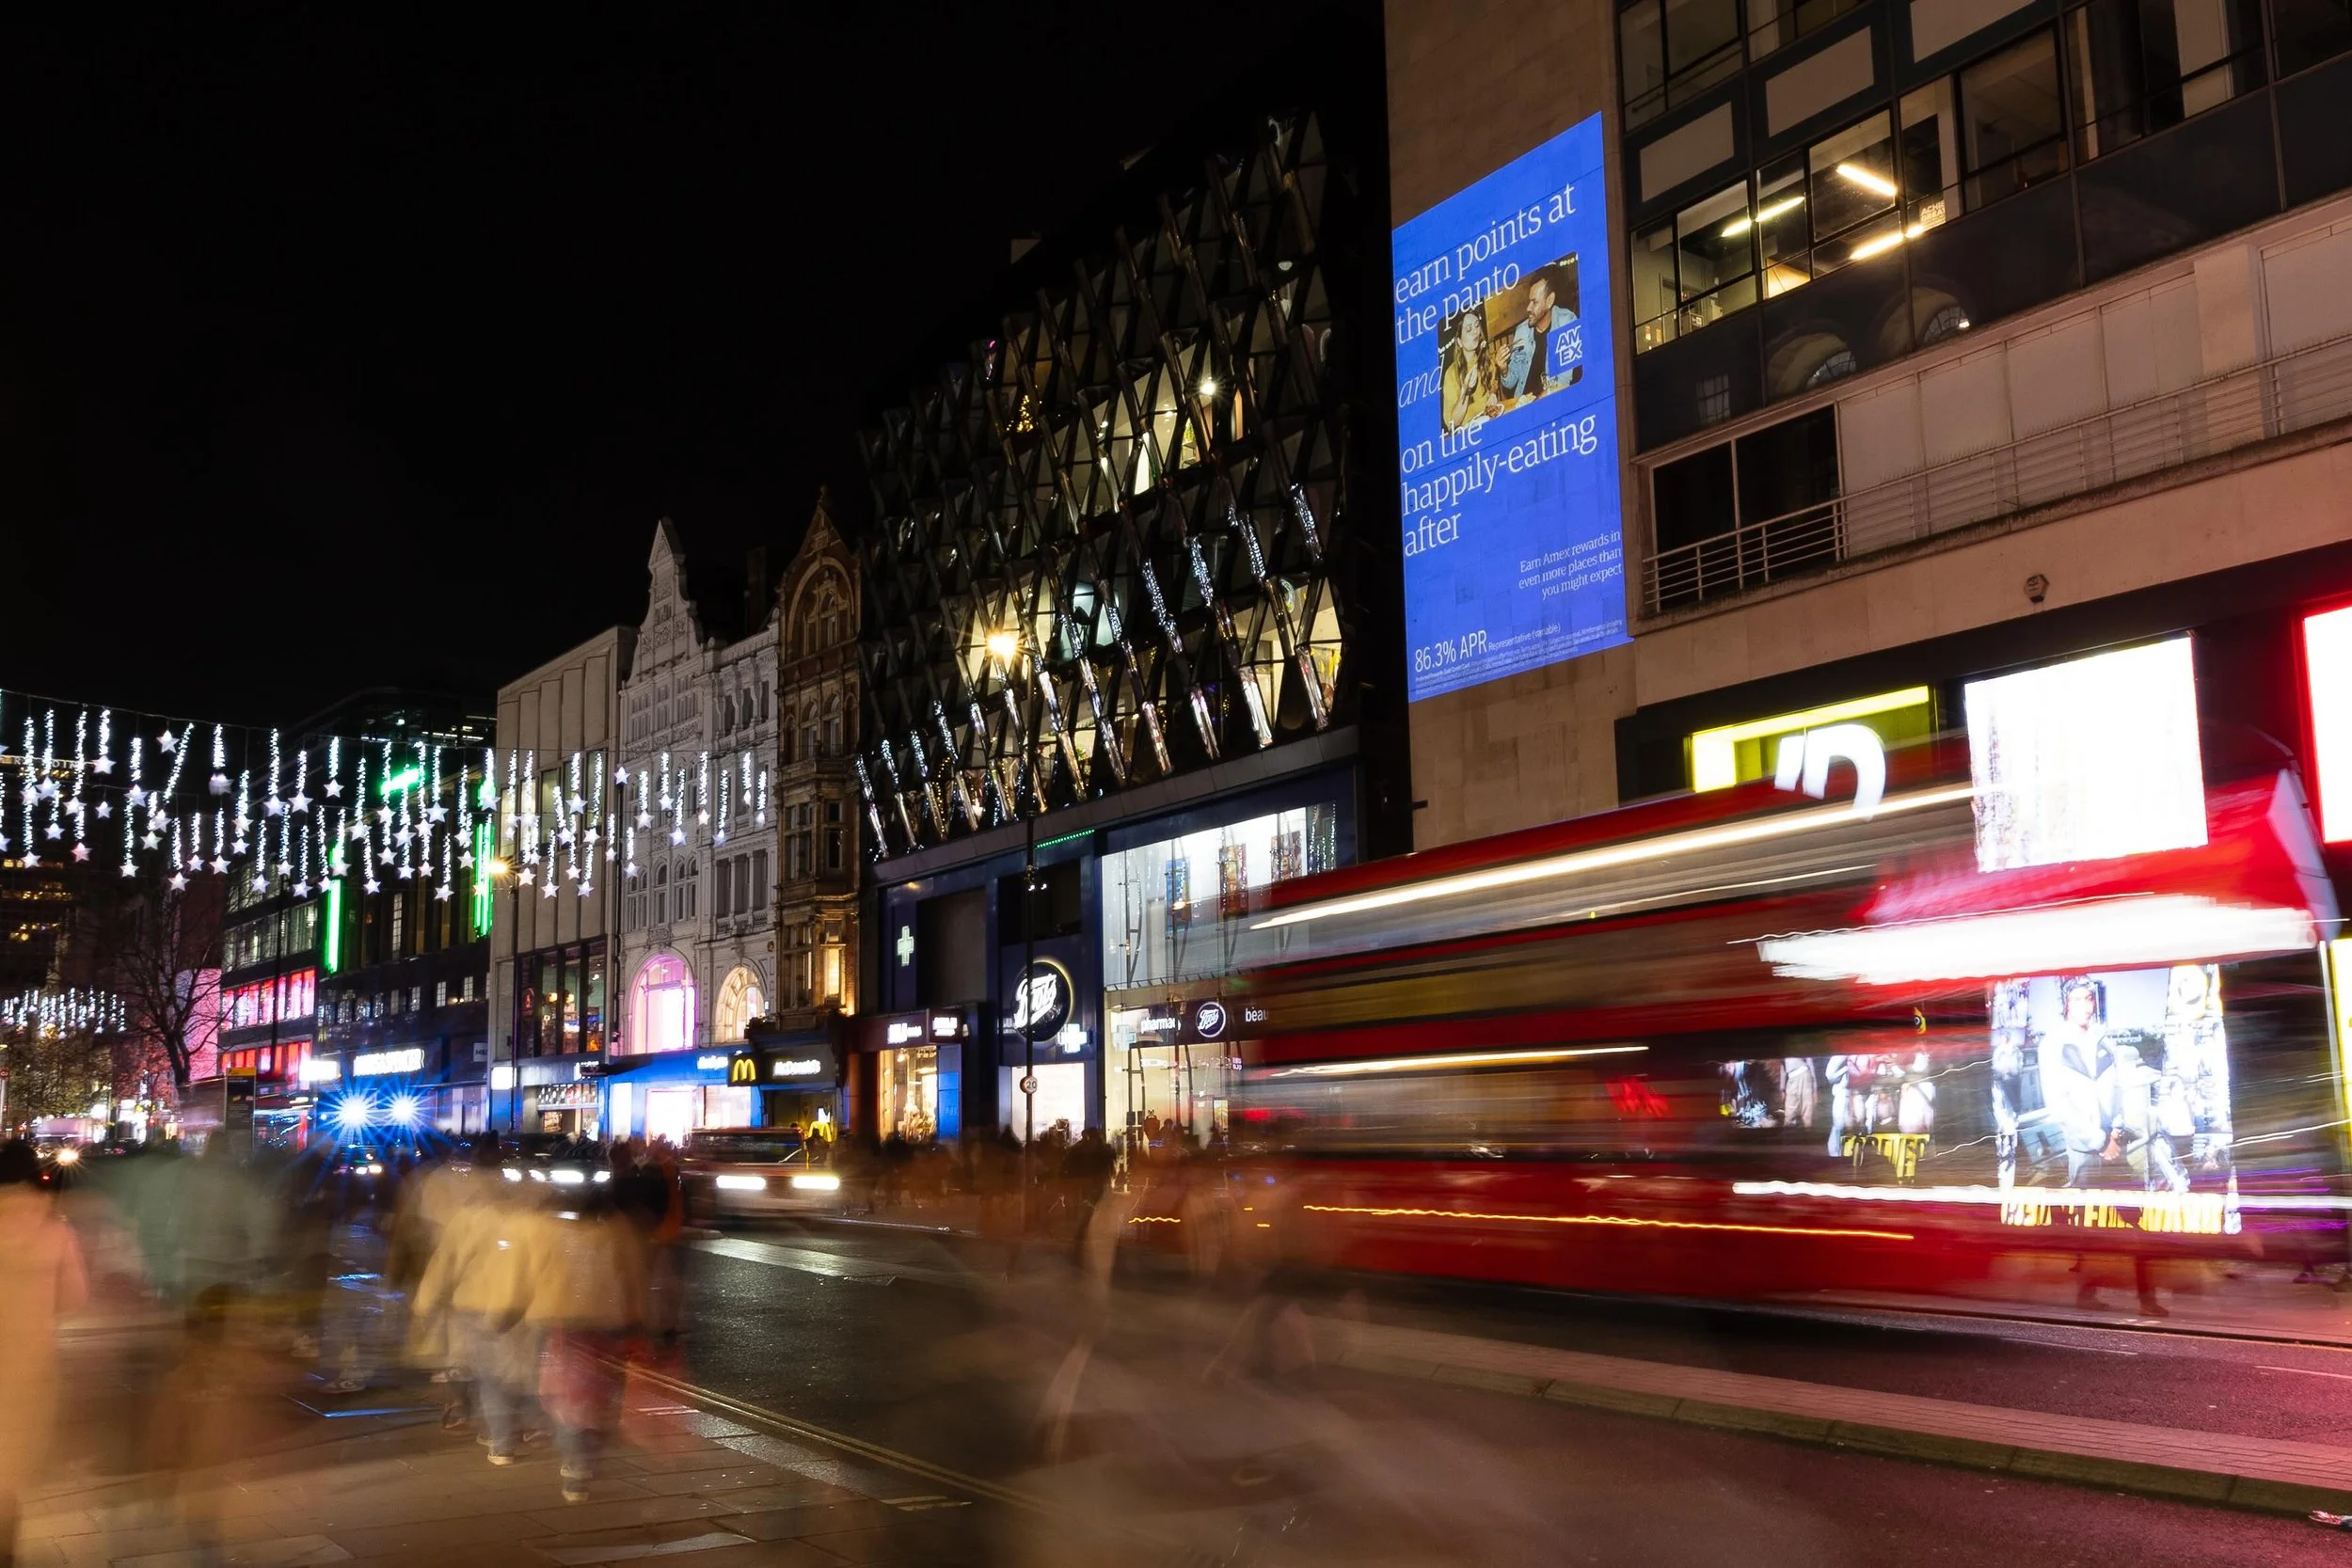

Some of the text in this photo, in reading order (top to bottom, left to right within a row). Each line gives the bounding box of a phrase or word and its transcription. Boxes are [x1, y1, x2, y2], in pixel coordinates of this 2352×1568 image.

[1395, 183, 1576, 304] earn points at
[1397, 262, 1519, 344] the panto
[1399, 354, 1445, 408] and
[1402, 420, 1482, 473] on the
[1402, 414, 1597, 515] happily-eating
[1405, 513, 1461, 557] after
[1520, 531, 1621, 573] Earn Amex rewards in
[1519, 548, 1622, 589] even more places than
[1542, 563, 1622, 600] you might expect
[1415, 641, 1456, 673] 86.3%
[1460, 629, 1486, 659] APR
[1488, 633, 1532, 652] Representative
[1198, 1009, 1219, 1030] Boots
[1026, 1081, 1038, 1089] 20
